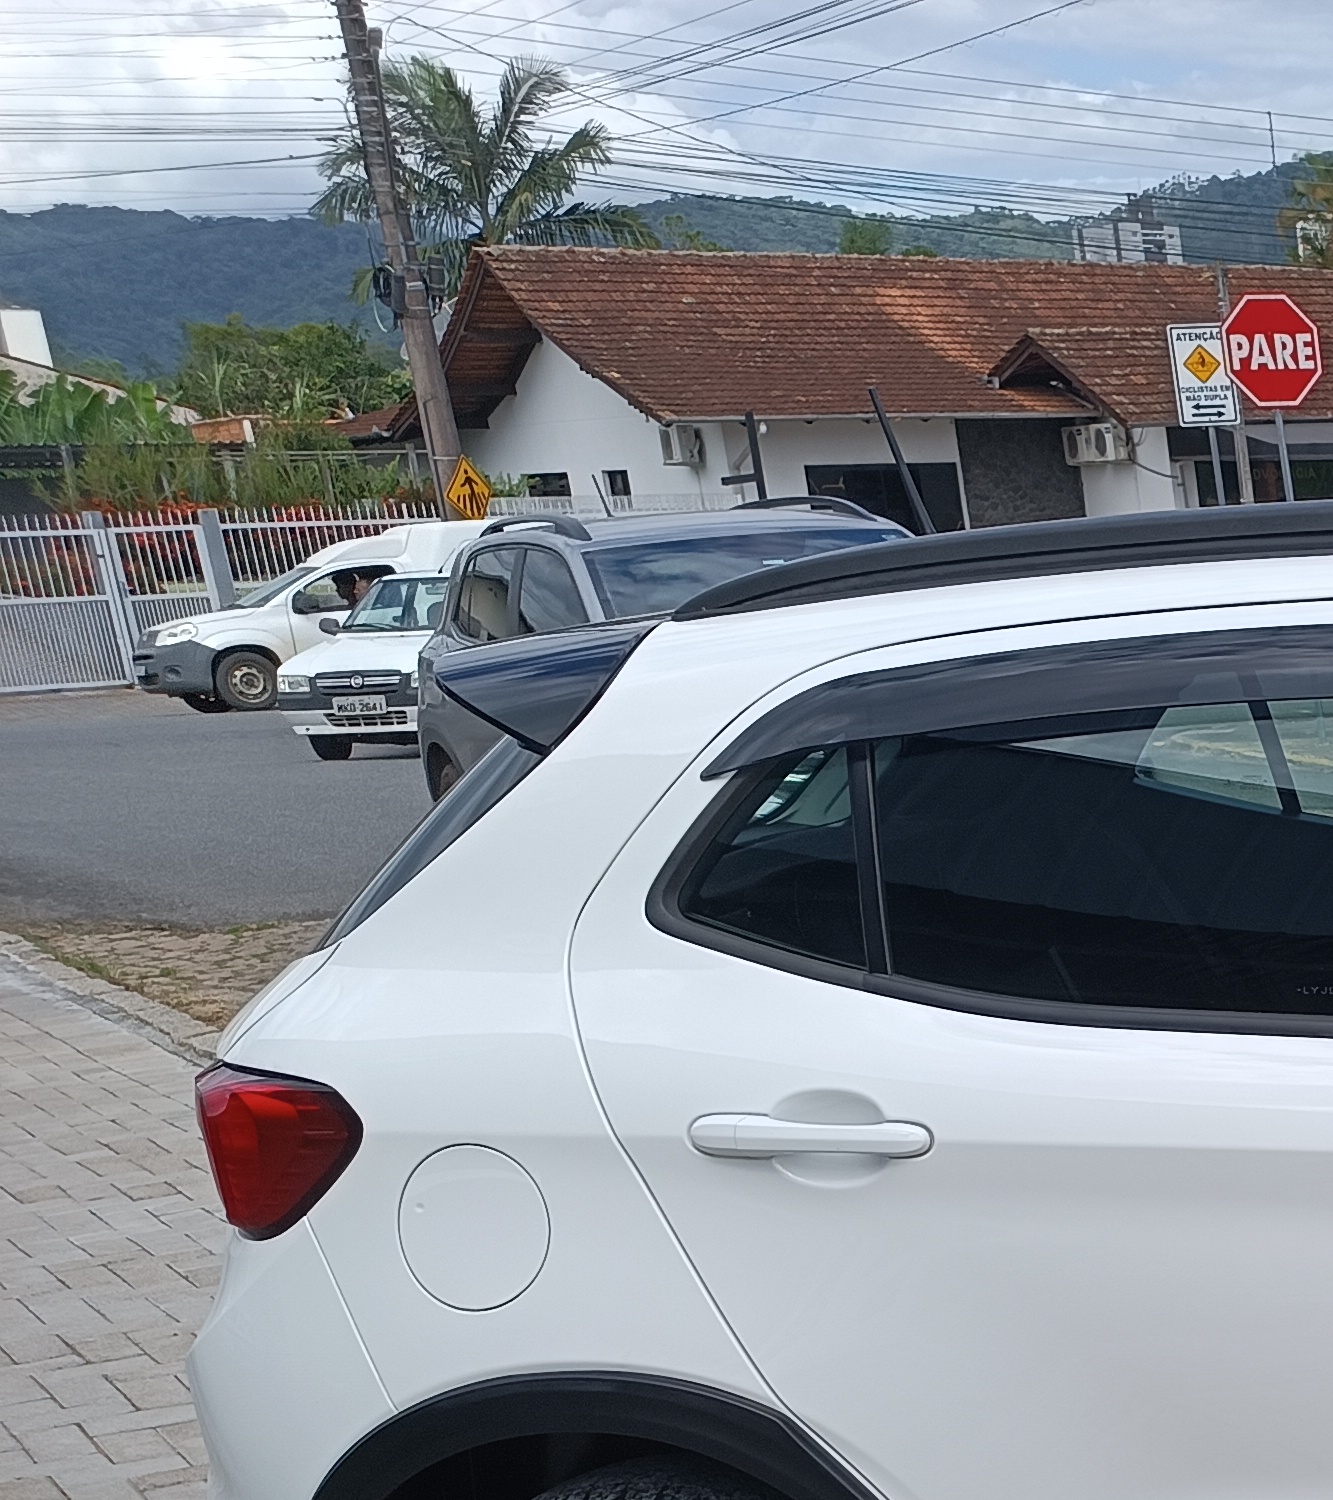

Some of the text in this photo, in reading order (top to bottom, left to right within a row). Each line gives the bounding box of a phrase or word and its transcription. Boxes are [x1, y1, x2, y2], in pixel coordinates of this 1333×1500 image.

[1229, 333, 1315, 371] PARE
[1181, 384, 1231, 393] CICLISTAS EM
